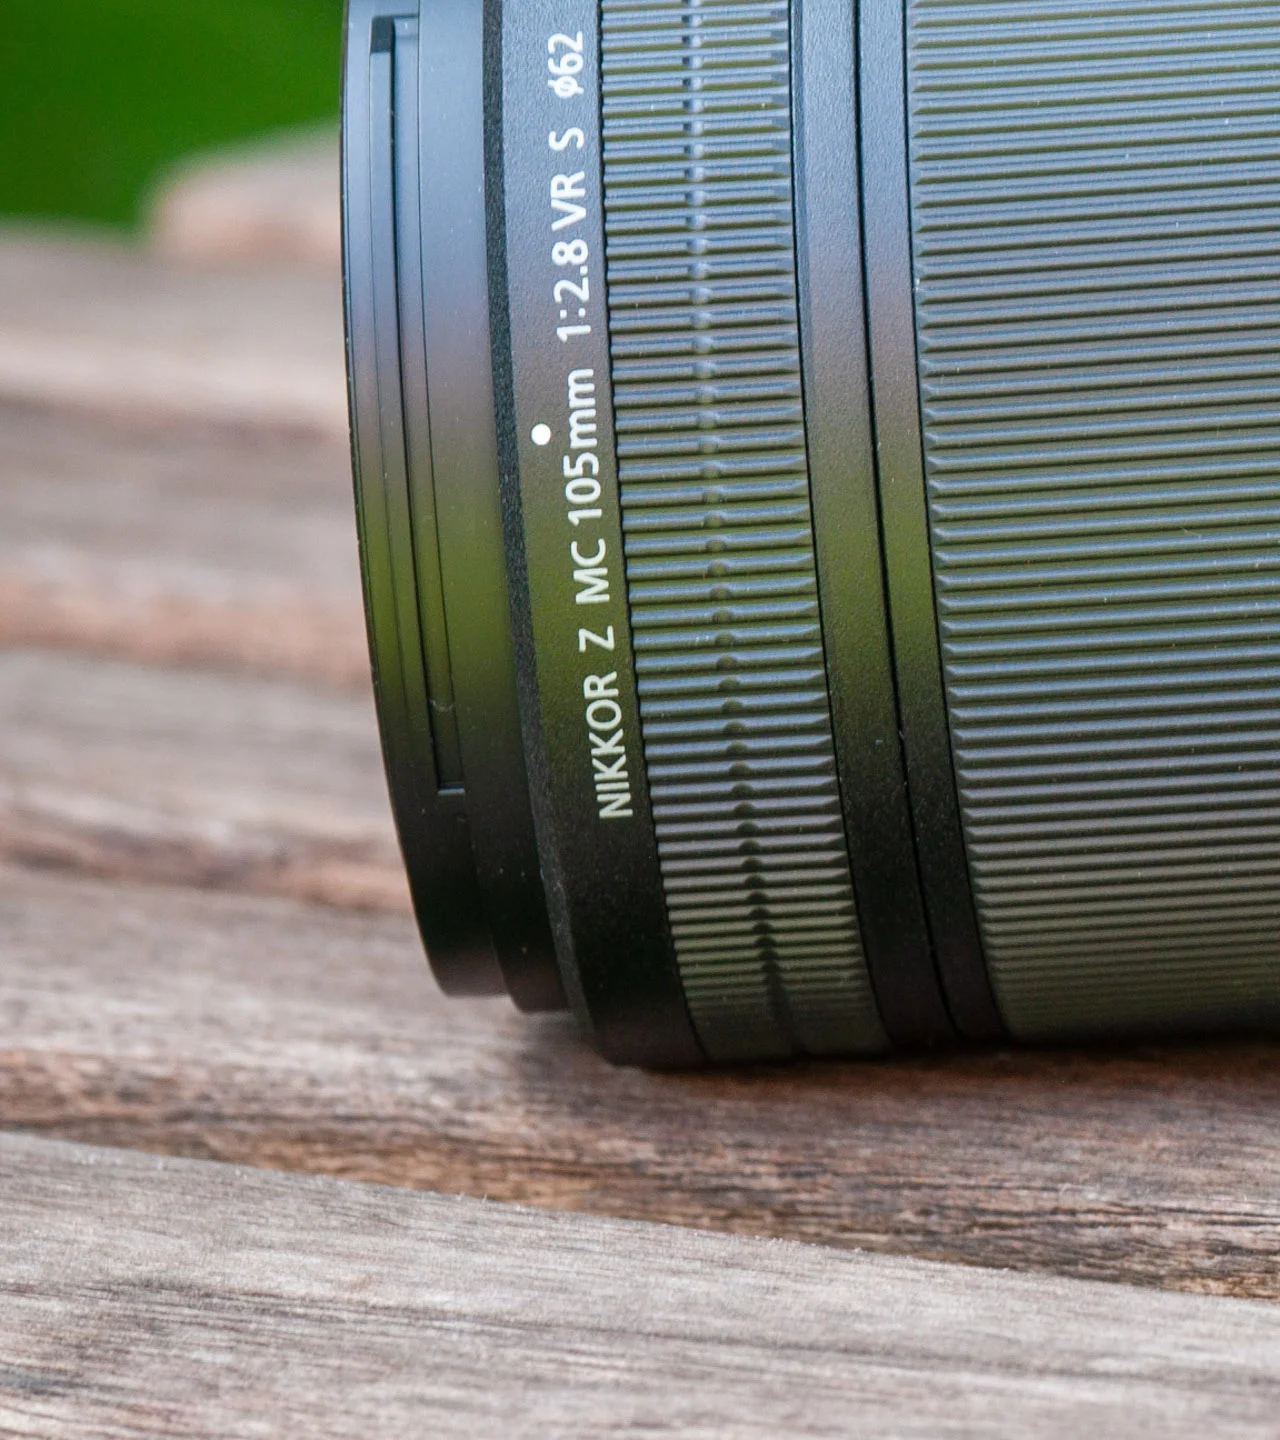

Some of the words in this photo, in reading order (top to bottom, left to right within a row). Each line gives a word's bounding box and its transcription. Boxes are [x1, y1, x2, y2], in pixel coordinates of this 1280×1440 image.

[548, 127, 584, 151] S
[550, 169, 586, 230] VR
[552, 235, 591, 341] 1:2.8
[563, 369, 602, 525] 105mm
[571, 539, 609, 603] MC
[579, 626, 614, 651] Z
[584, 671, 632, 817] NIKKOR
